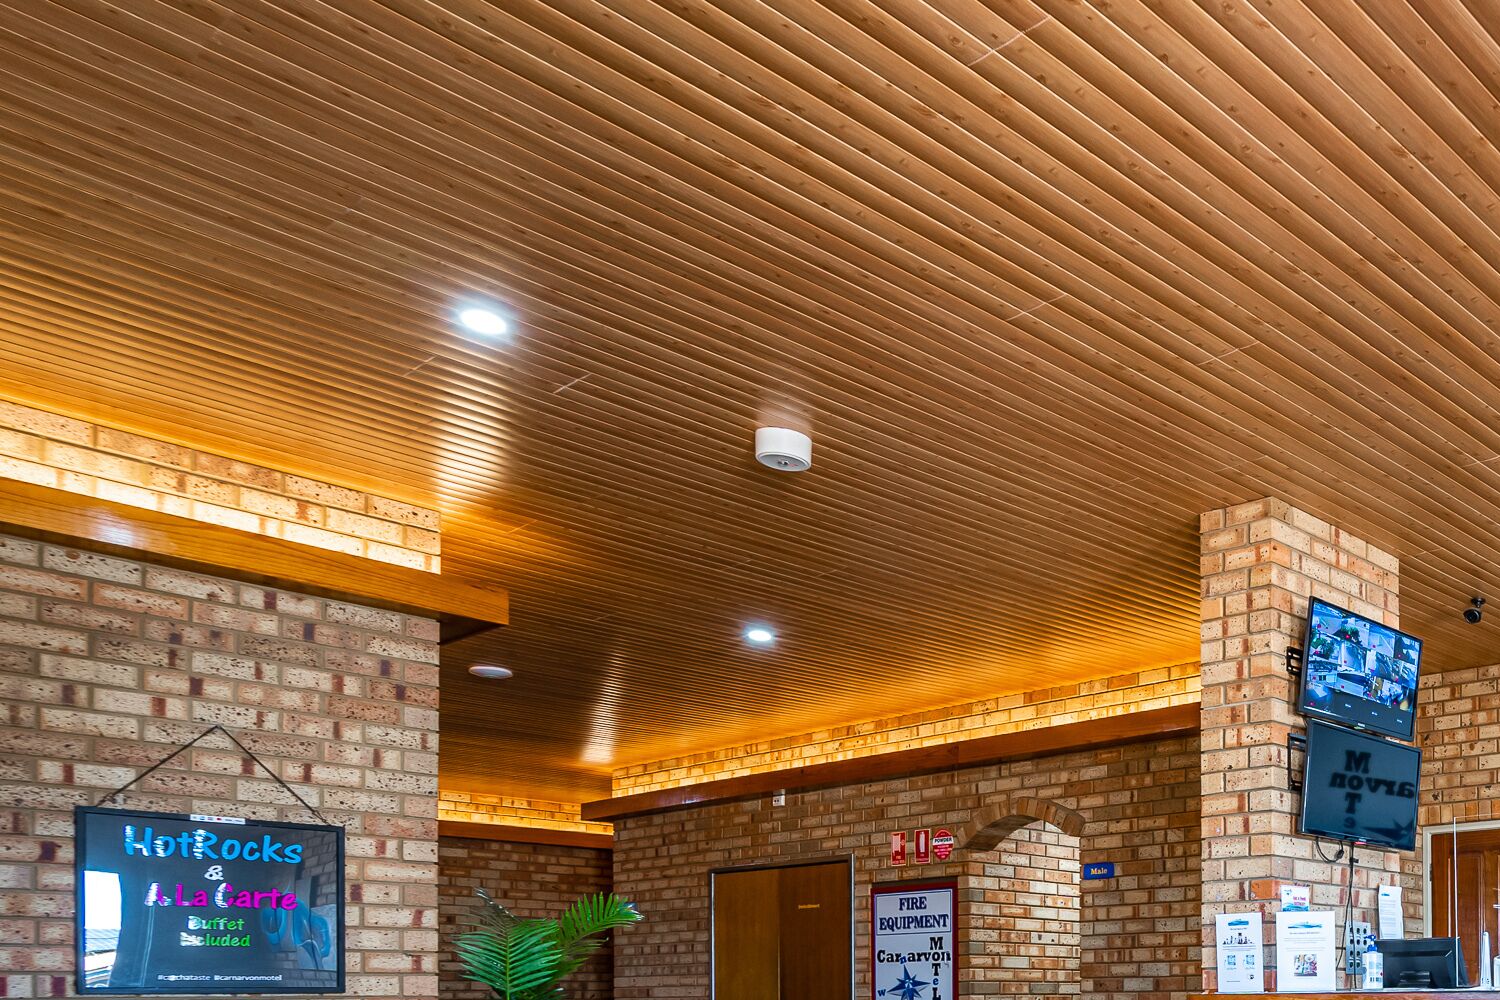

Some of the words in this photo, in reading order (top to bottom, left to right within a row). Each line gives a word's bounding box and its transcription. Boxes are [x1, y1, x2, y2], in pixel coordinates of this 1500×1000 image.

[204, 865, 225, 881] &
[1091, 867, 1108, 875] Male
[145, 882, 168, 907] A
[176, 882, 208, 907] La
[214, 882, 299, 911] Carte
[898, 896, 928, 912] FIRE
[187, 915, 245, 931] Buffet
[879, 914, 949, 932] EQUIPMENT
[877, 949, 951, 965] Carnarvon
